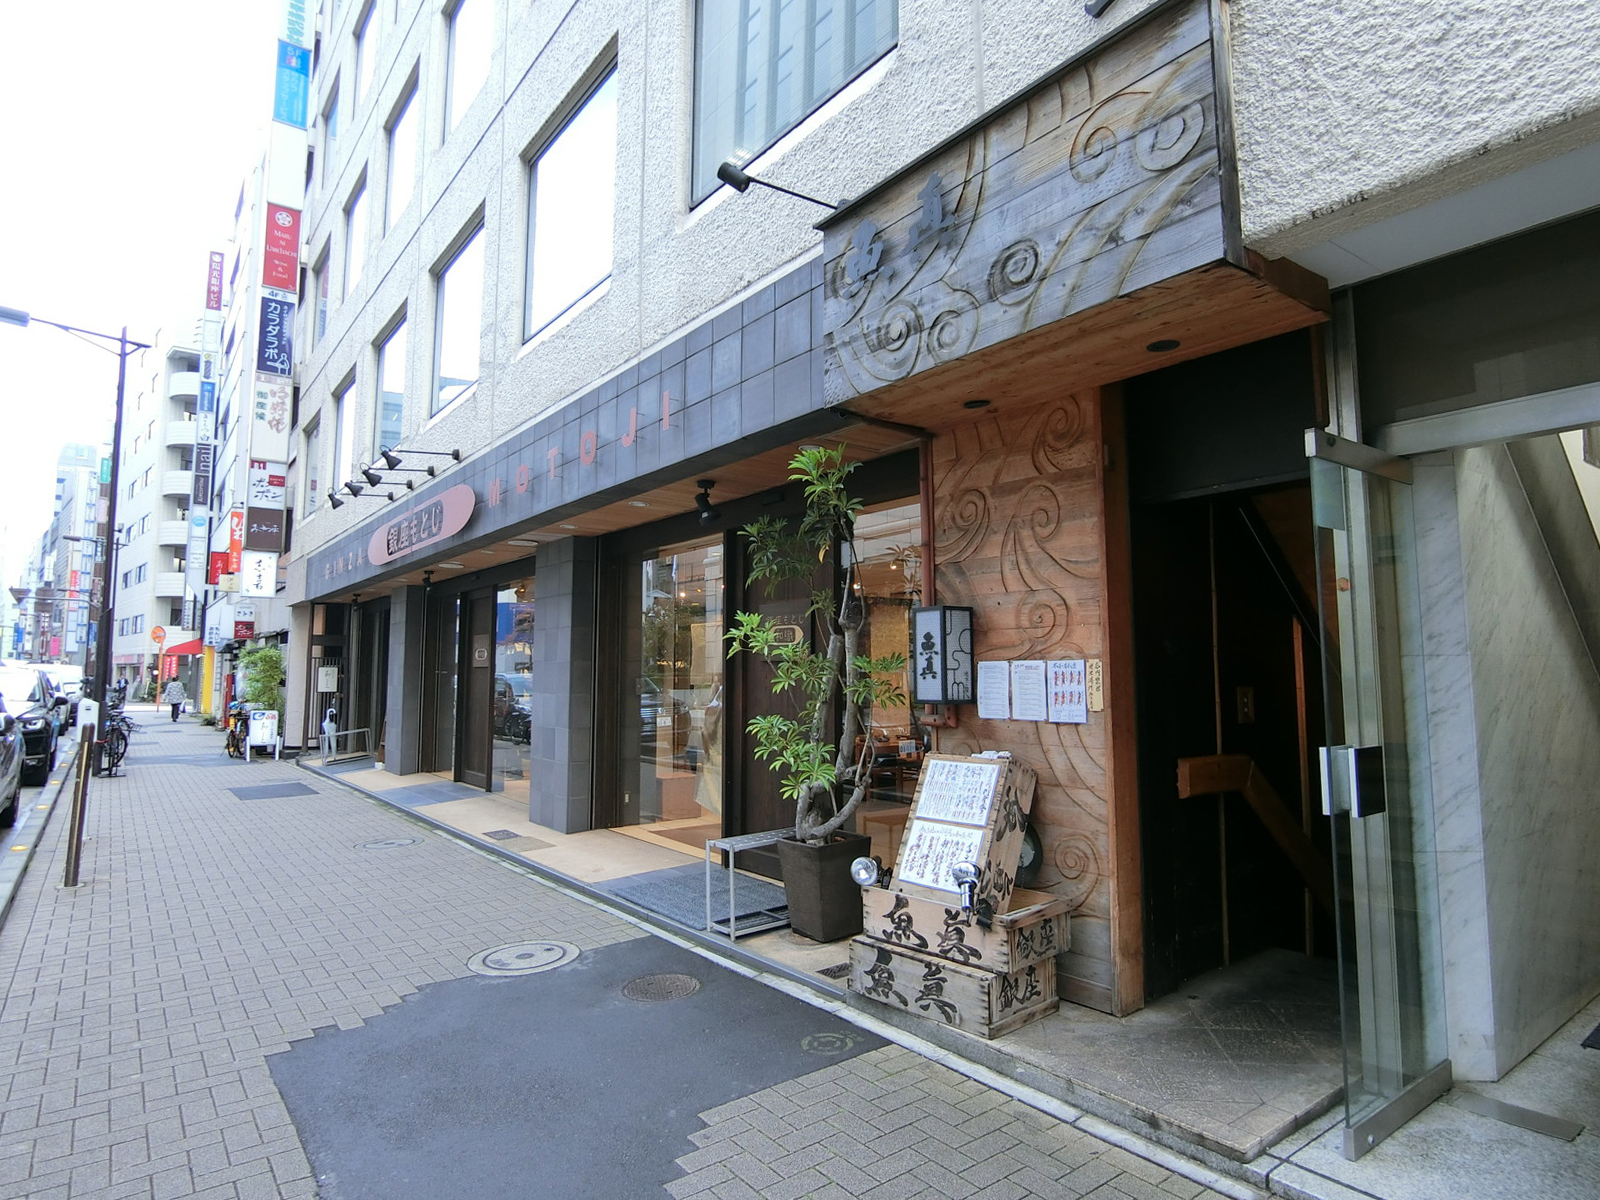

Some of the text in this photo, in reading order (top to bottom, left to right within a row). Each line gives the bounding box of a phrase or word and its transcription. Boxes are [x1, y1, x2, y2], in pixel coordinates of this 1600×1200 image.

[264, 301, 280, 359] カラダラボ
[489, 391, 670, 508] MOTOJI
[388, 505, 441, 553] 銀座もとじ
[325, 547, 363, 579] GINZA
